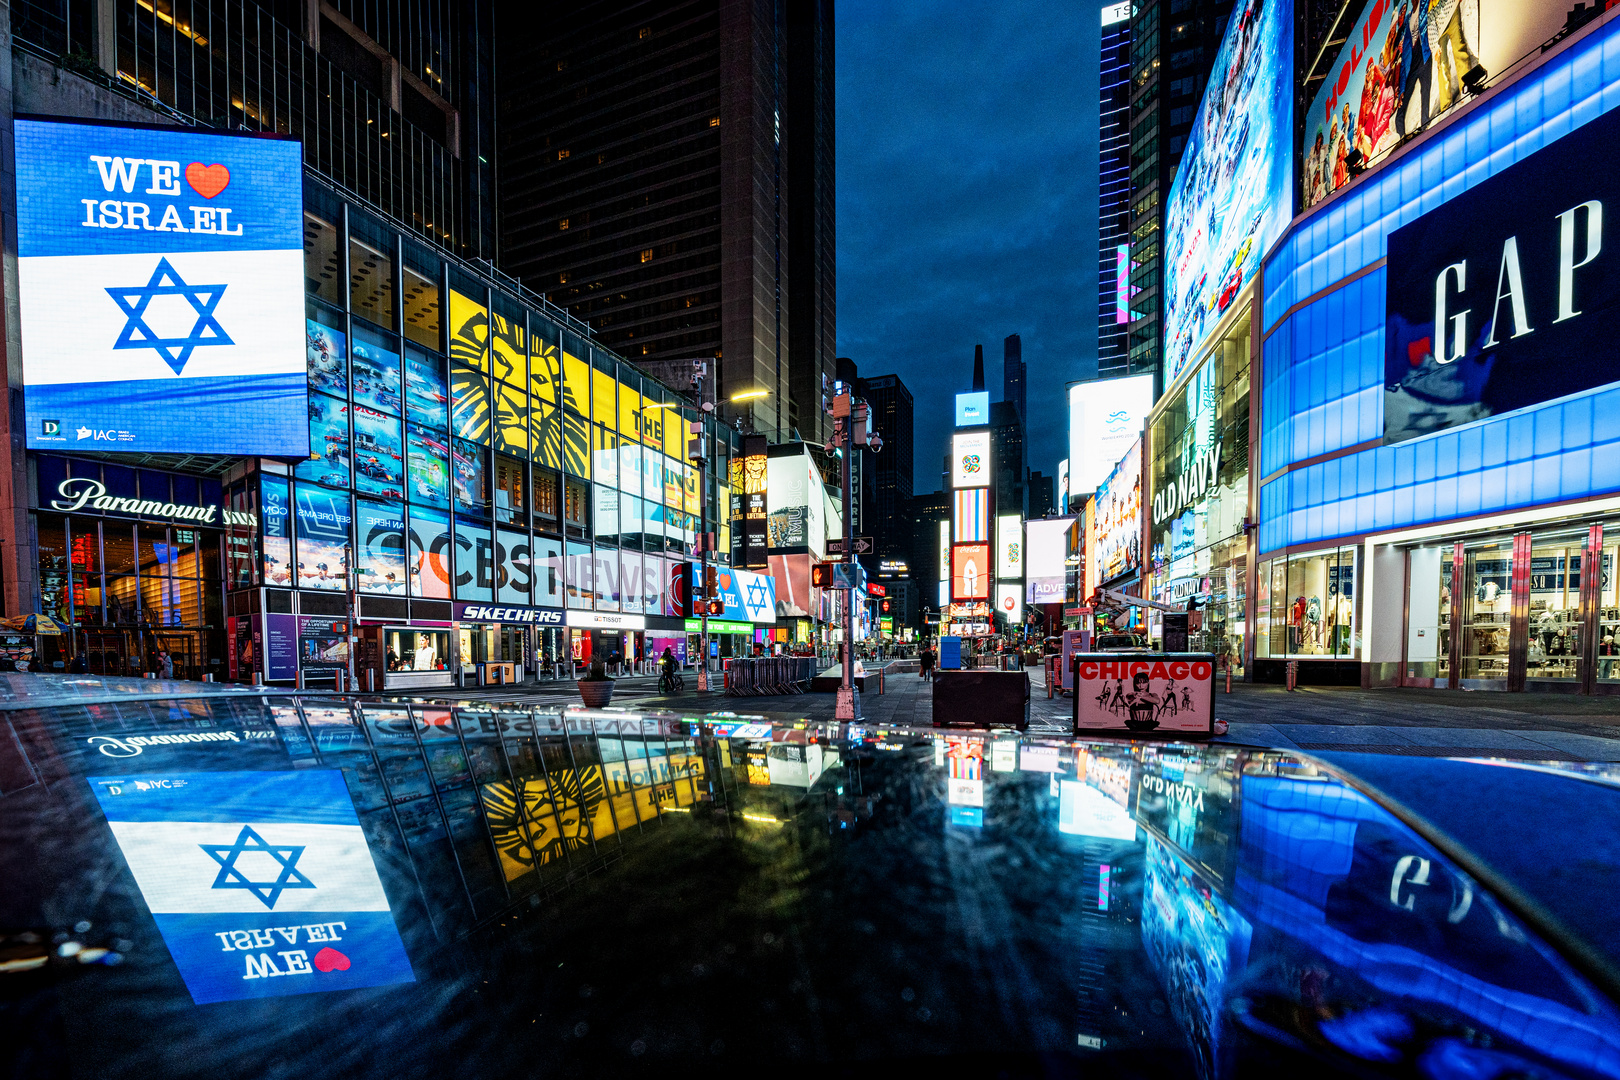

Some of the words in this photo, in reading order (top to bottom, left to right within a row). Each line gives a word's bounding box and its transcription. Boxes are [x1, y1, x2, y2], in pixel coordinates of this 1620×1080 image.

[1325, 0, 1391, 124] HOLID
[90, 155, 181, 196] WE
[81, 199, 243, 236] ISRAEL
[1434, 199, 1603, 365] GAP
[93, 429, 116, 441] IAC
[632, 409, 662, 442] THE
[51, 478, 216, 523] Paramount
[1154, 481, 1176, 525] OLD
[1179, 442, 1222, 510] NAVY
[788, 479, 802, 535] MUSIC
[429, 531, 537, 593] CBS
[548, 549, 658, 605] NEWS
[1174, 583, 1184, 598] OLD
[1185, 578, 1200, 596] NAVY
[463, 605, 562, 623] SKECHERS
[1079, 661, 1212, 681] CHICAGO
